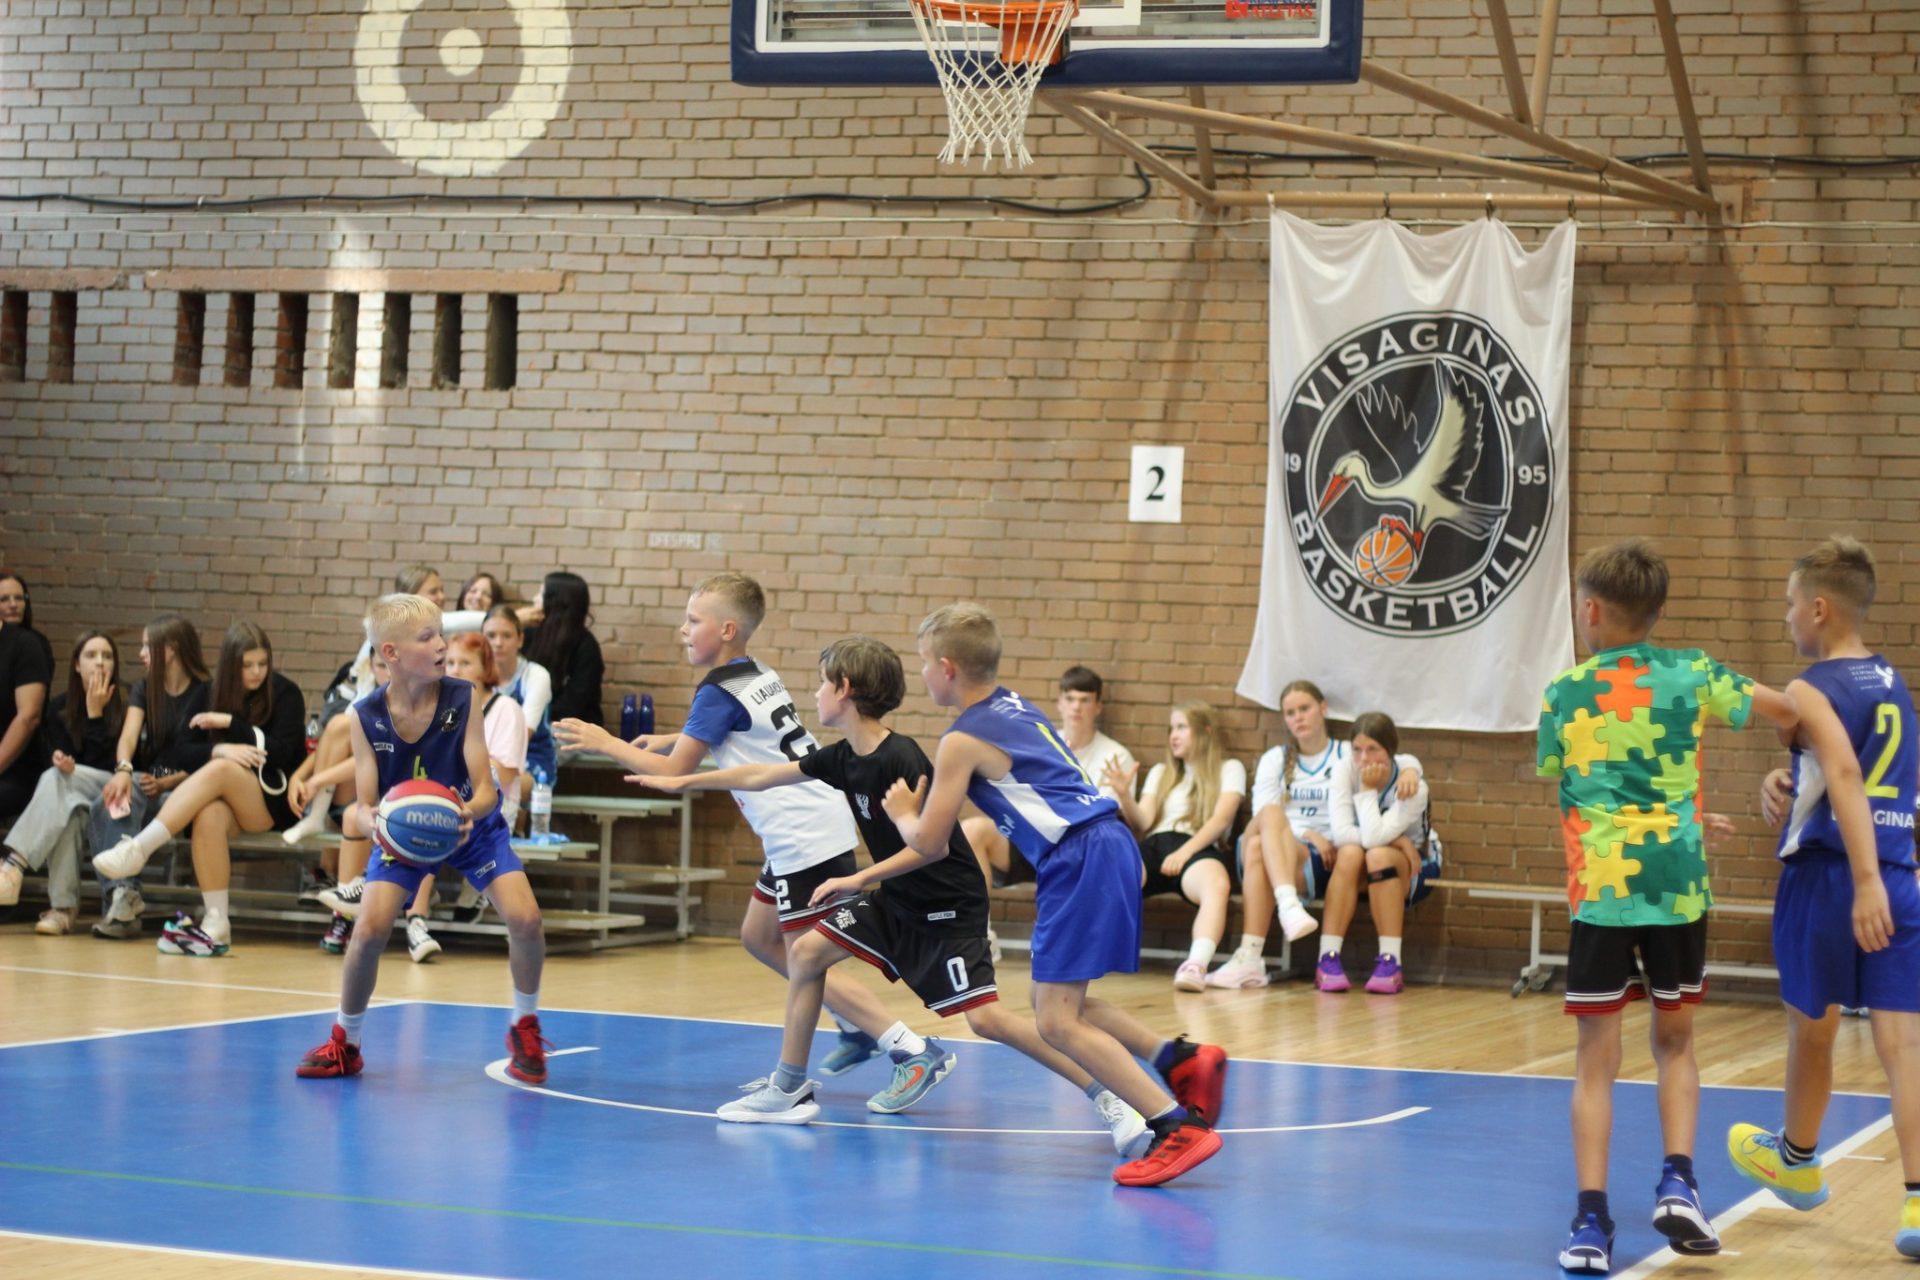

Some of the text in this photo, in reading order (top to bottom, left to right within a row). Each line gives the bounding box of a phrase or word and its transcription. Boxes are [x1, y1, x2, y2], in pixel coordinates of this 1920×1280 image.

[1296, 321, 1536, 428] VISAGINAS
[1284, 452, 1302, 473] 19
[1518, 464, 1547, 486] 95
[1145, 465, 1165, 501] 2
[1291, 511, 1537, 629] BASKETBALL
[1864, 702, 1902, 799] 2
[406, 810, 459, 831] molten
[946, 956, 969, 992] 0
